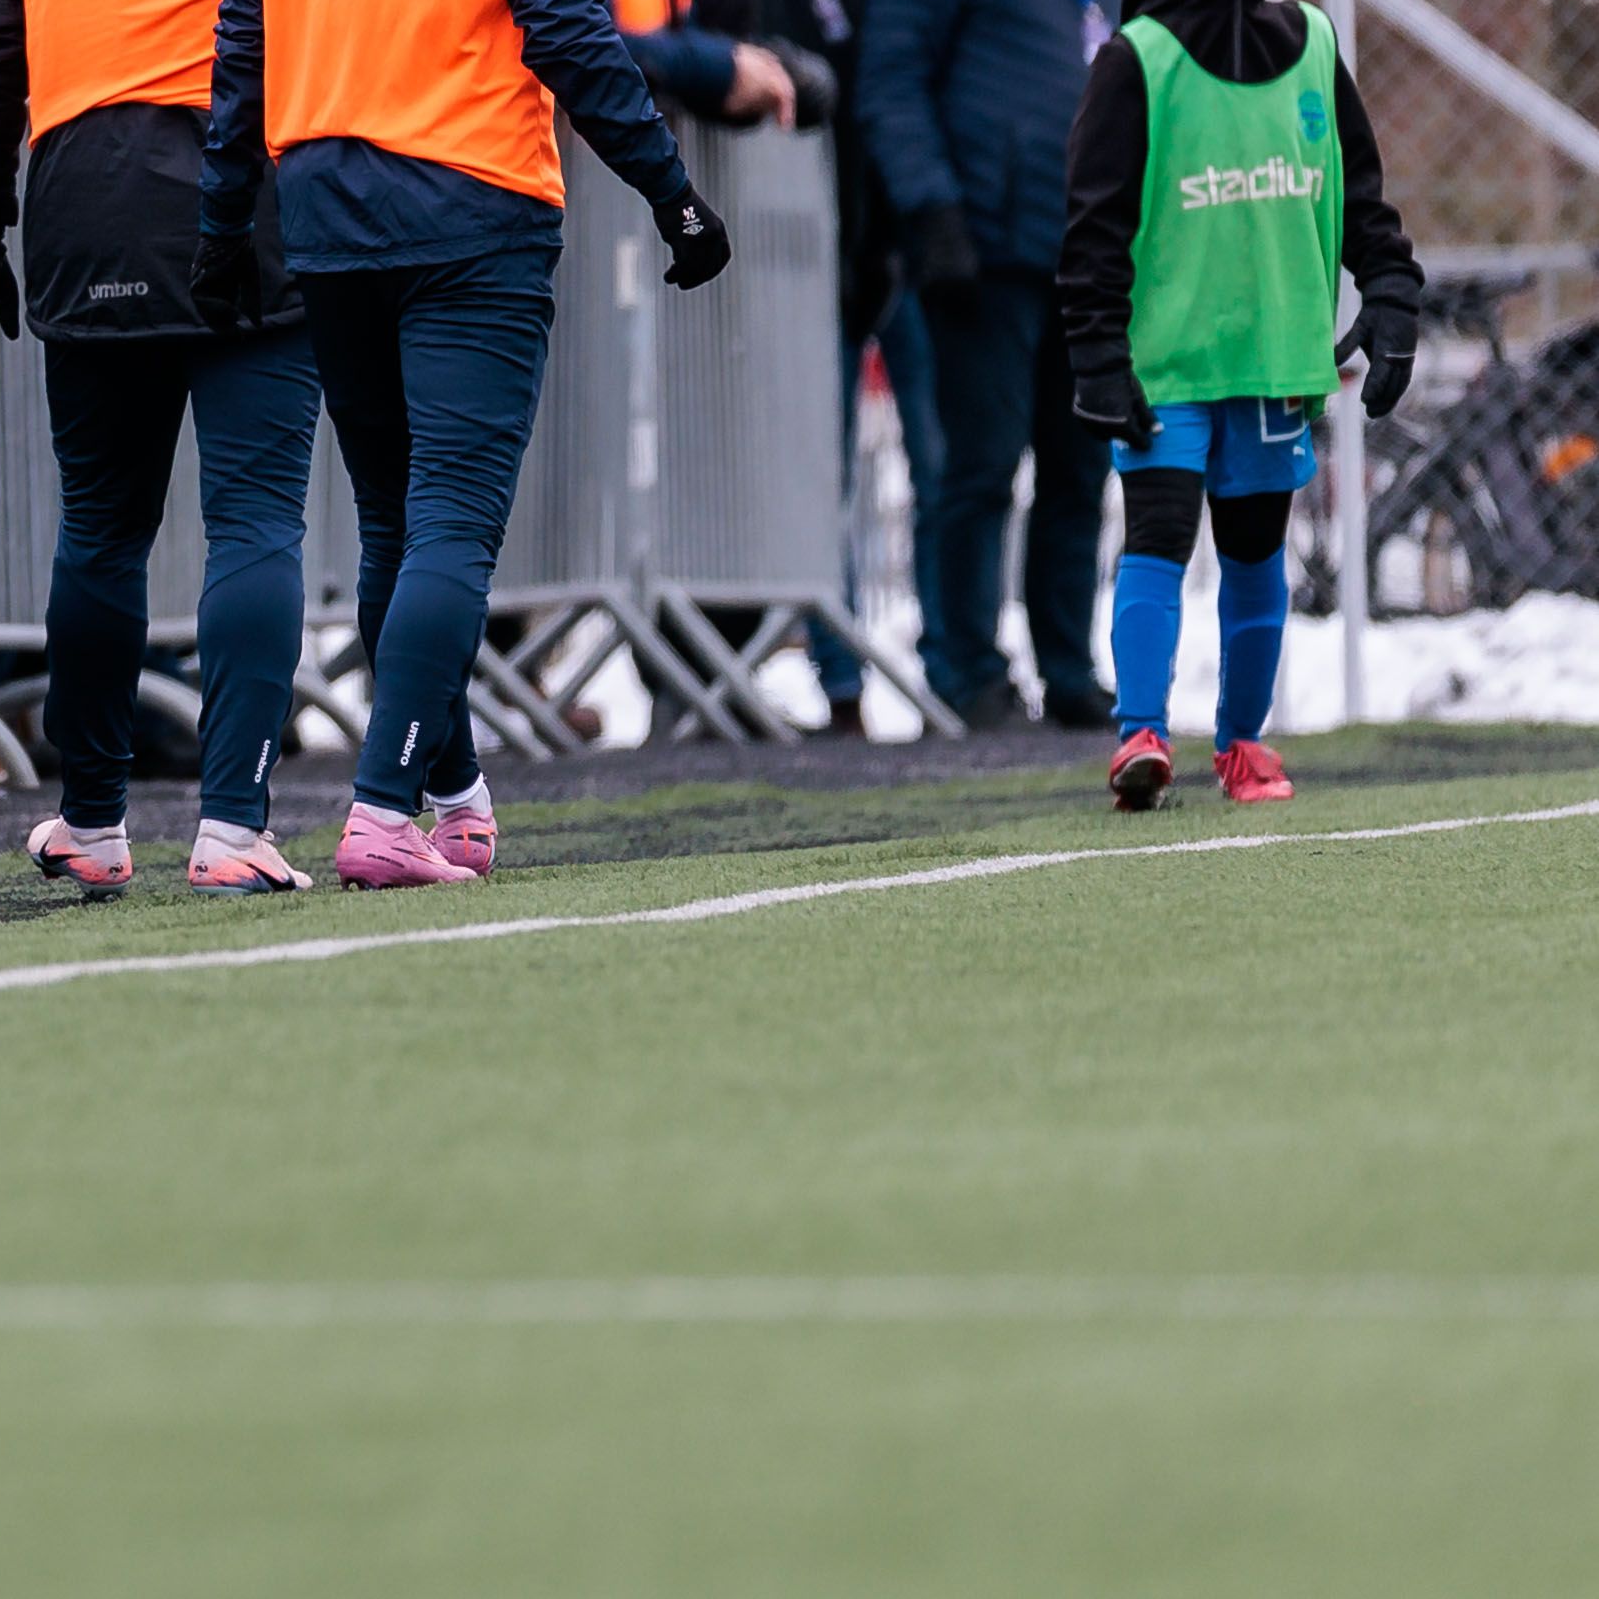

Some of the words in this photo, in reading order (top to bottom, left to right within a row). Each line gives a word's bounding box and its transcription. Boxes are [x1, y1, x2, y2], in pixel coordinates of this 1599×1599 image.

[88, 280, 150, 300] umbro
[253, 738, 272, 784] umbro
[400, 720, 421, 767] umbro
